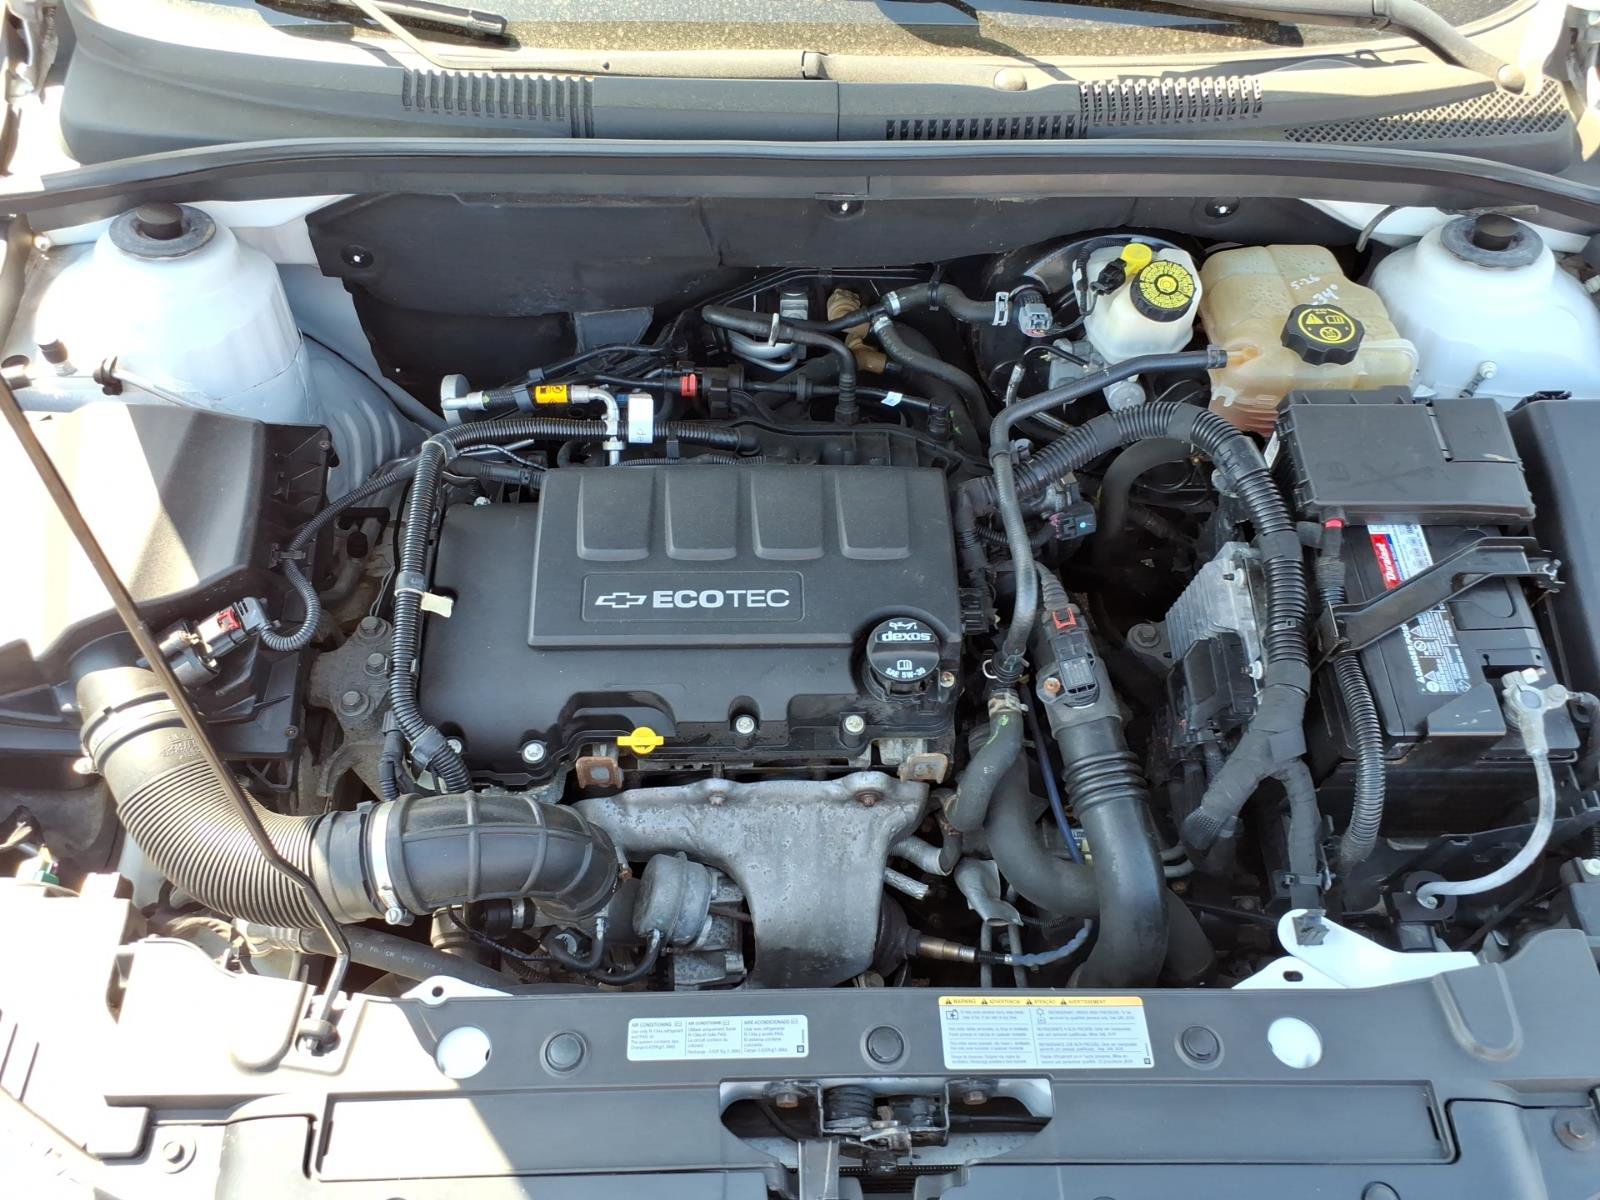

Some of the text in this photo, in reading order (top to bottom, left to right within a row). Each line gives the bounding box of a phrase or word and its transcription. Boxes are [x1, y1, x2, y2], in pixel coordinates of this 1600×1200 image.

[1375, 542, 1397, 582] Duralast
[653, 589, 790, 608] ECOTEC
[881, 630, 932, 641] dexos
[1400, 623, 1423, 677] DANGER/POIS
[885, 667, 926, 678] SAE 5W-30
